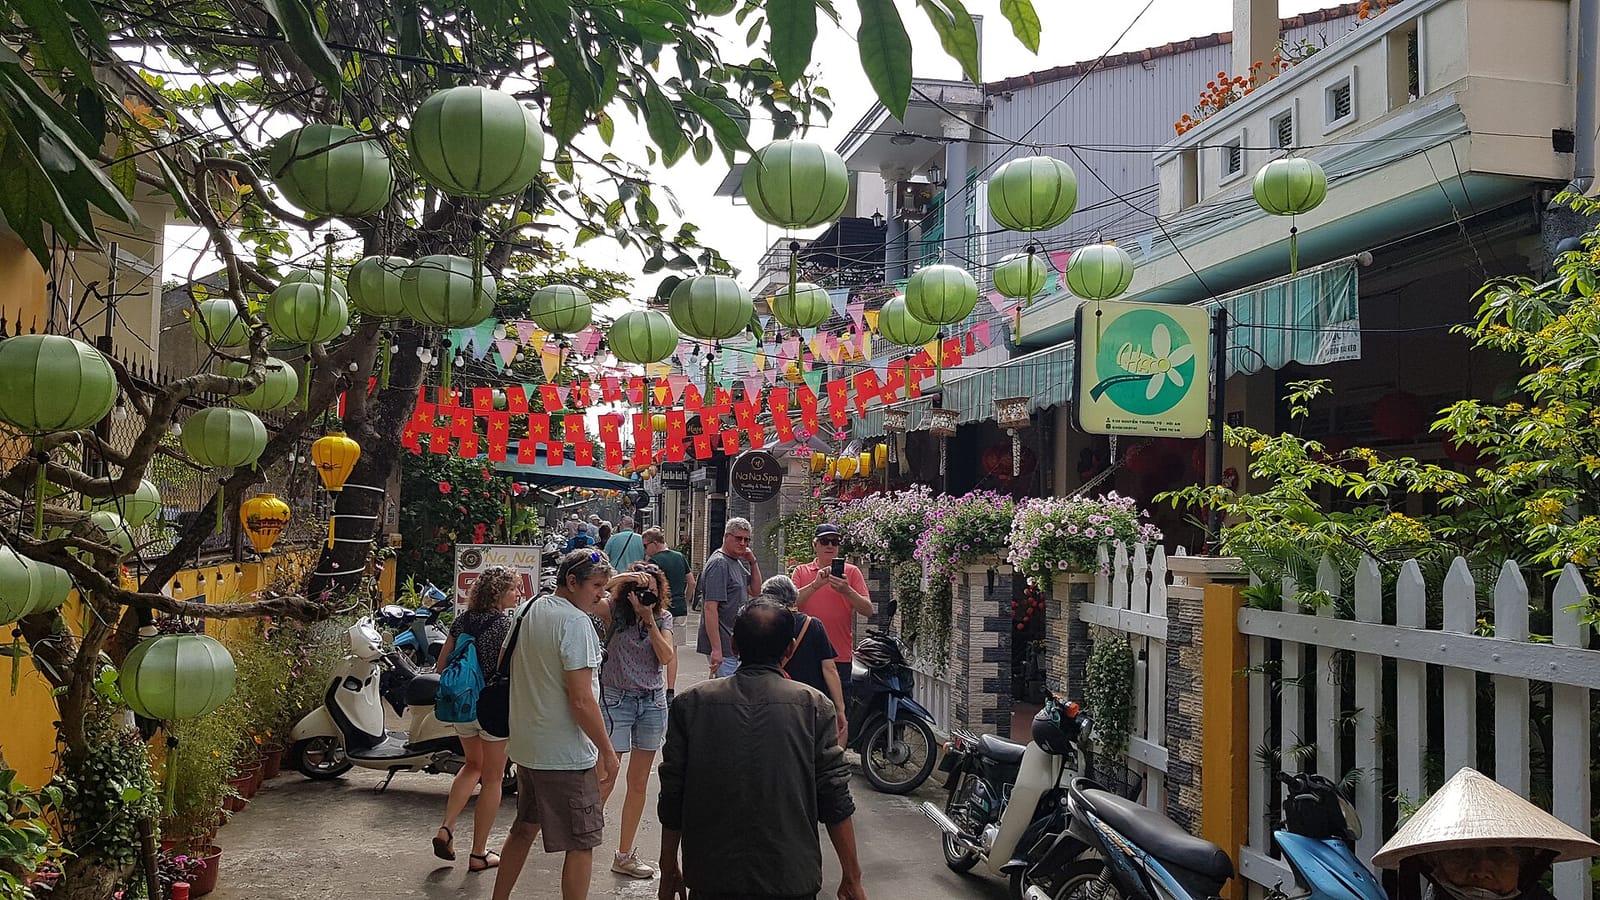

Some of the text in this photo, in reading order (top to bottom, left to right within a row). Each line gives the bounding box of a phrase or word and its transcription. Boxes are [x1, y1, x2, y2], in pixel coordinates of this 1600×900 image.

[762, 472, 778, 485] Spa
[485, 551, 537, 564] Na Na
